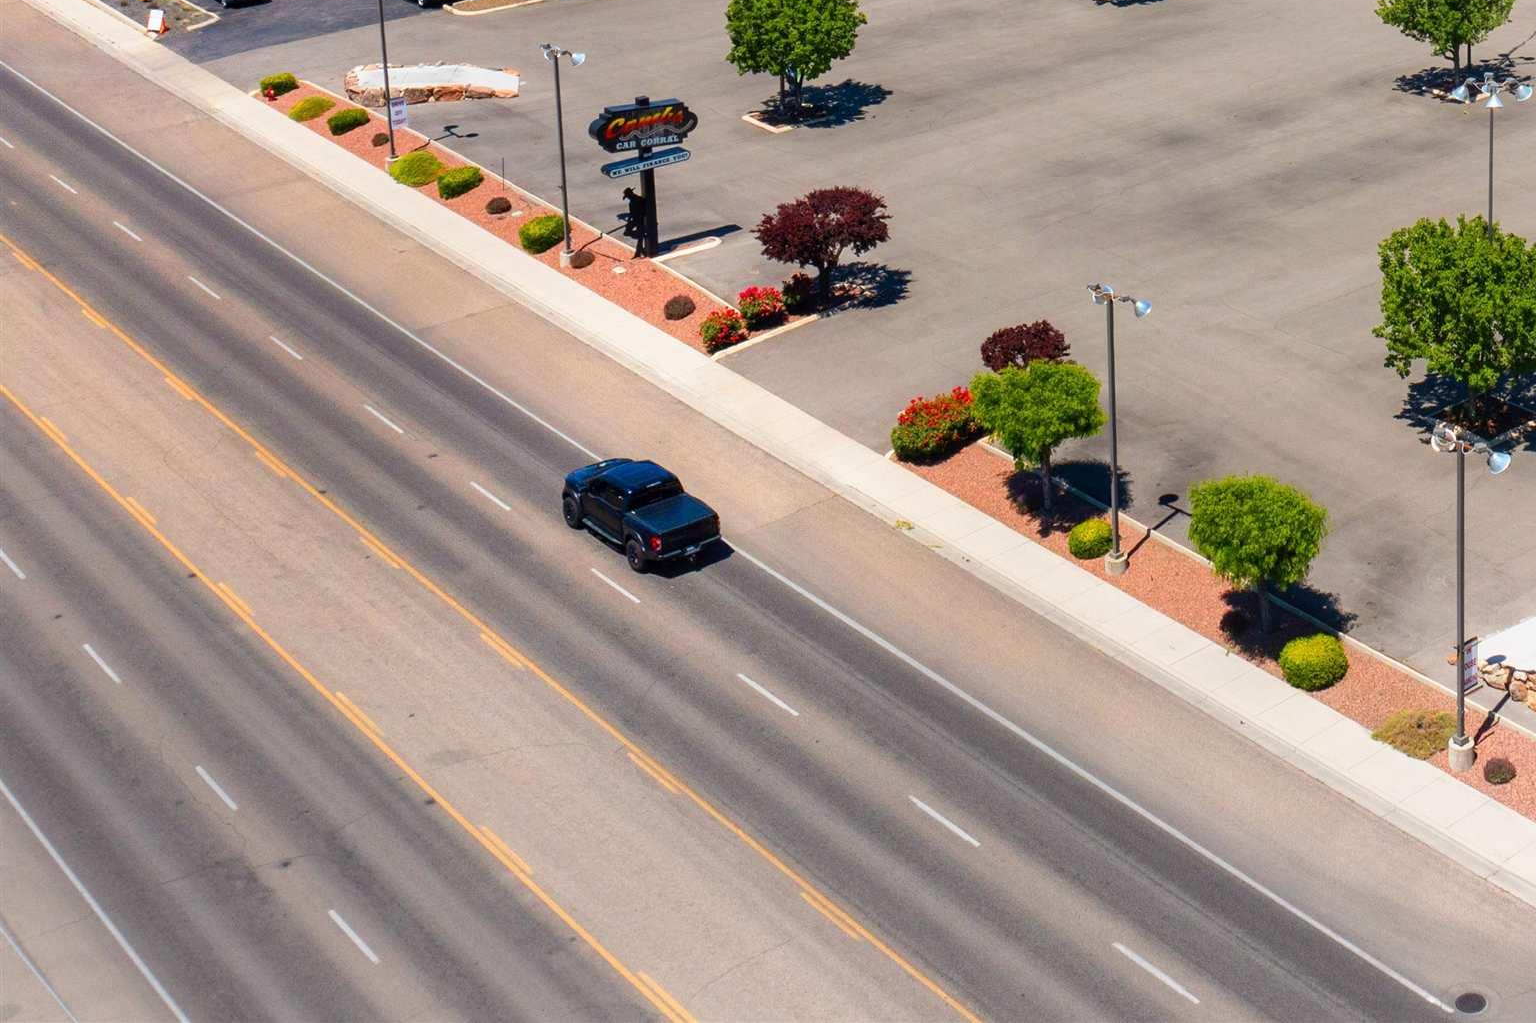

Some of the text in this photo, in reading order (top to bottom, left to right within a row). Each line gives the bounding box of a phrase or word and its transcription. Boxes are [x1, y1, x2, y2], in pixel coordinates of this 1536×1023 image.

[616, 135, 679, 151] CAR CORRAL
[624, 164, 641, 174] WILL
[642, 157, 670, 168] FINANCE
